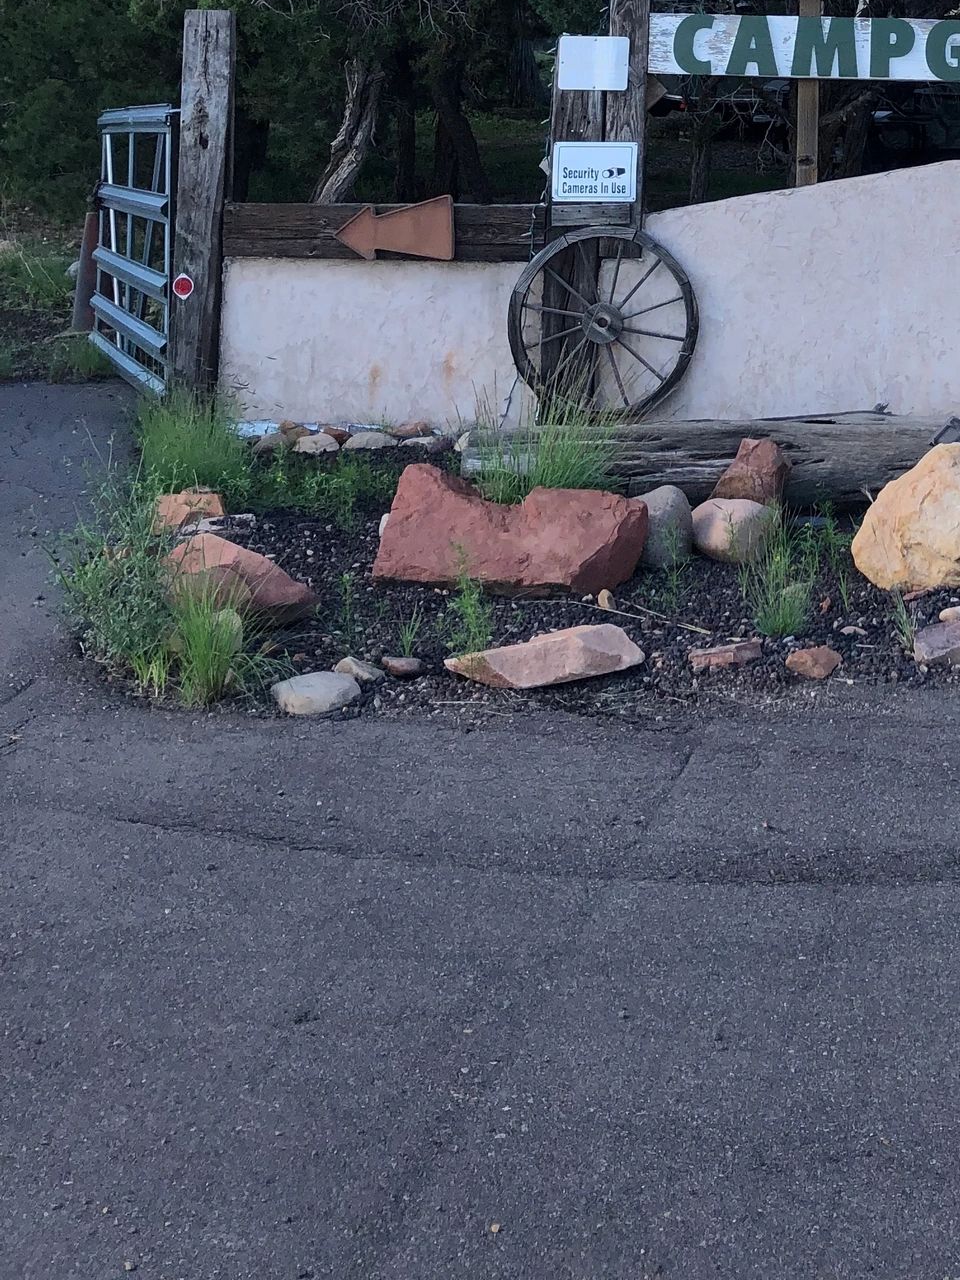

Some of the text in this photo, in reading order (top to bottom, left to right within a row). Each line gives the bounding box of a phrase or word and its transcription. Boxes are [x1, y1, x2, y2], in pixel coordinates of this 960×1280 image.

[562, 166, 599, 181] Security
[562, 181, 627, 194] Cameras In Use
